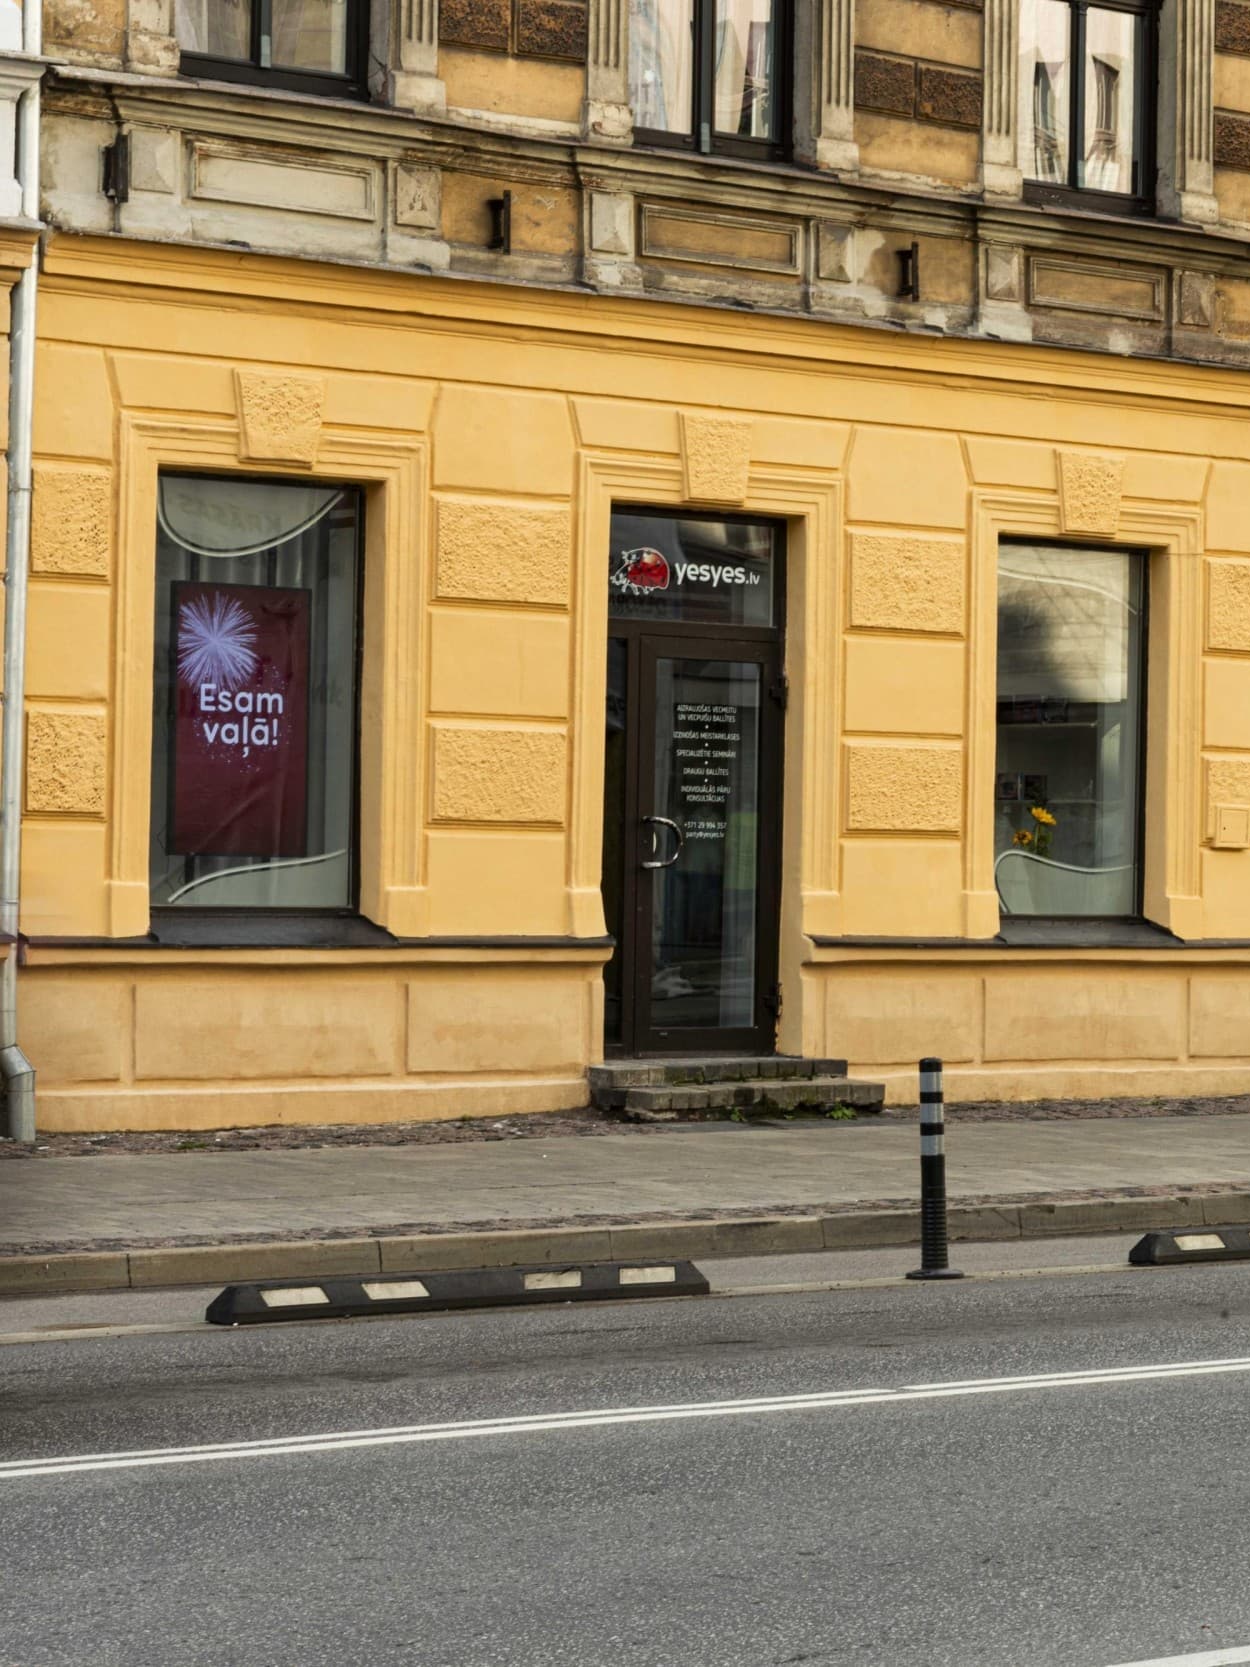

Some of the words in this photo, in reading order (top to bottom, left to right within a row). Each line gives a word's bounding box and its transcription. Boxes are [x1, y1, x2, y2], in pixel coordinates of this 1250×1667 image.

[674, 562, 760, 588] yesyes.lv
[199, 683, 284, 714] Esam
[203, 716, 279, 758] vaļā!
